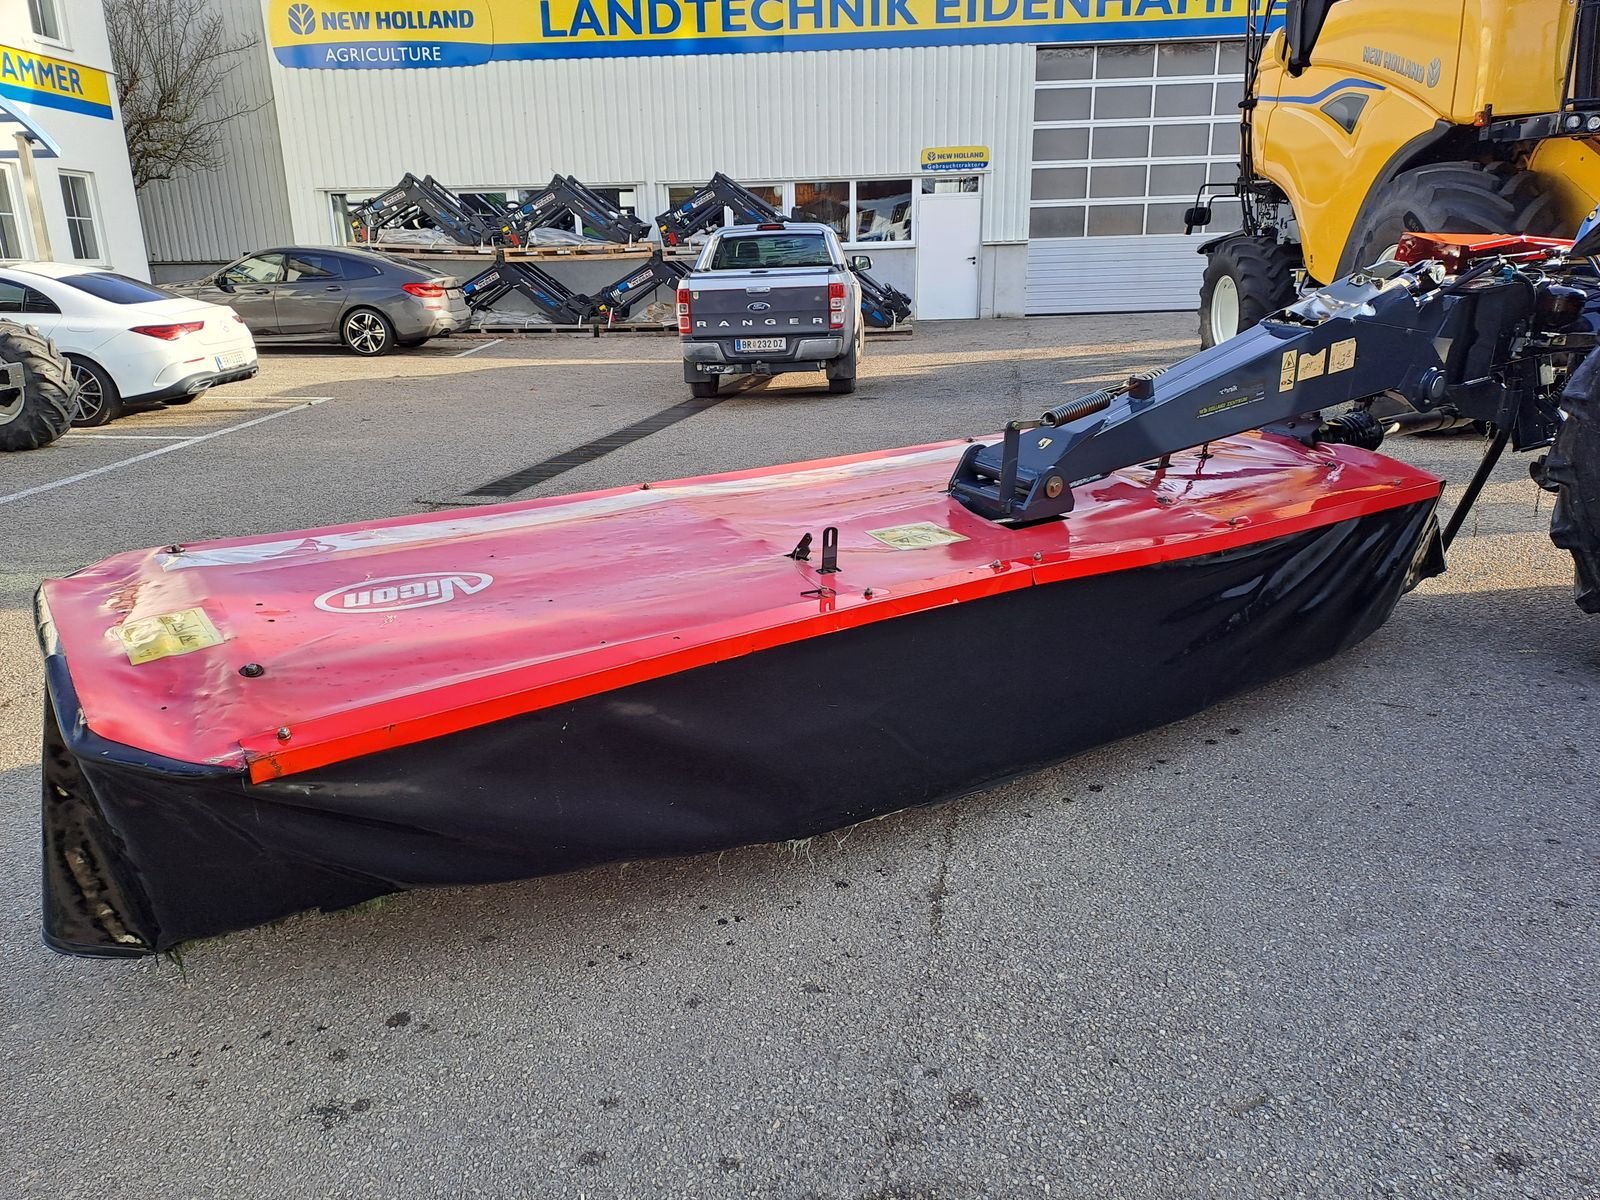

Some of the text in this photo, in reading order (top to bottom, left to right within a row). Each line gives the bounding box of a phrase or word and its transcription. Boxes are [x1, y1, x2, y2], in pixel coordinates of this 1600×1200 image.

[321, 10, 474, 31] NEW HOLLAND
[541, 0, 919, 38] LANDTECHNIK
[326, 47, 441, 62] AGRICULTURE
[1363, 46, 1425, 84] NEW HOLLAND
[2, 51, 84, 95] AMMER
[954, 151, 984, 159] HOLLAND
[697, 317, 823, 328] RANGER
[757, 340, 772, 349] 232
[341, 574, 493, 609] Vicon
